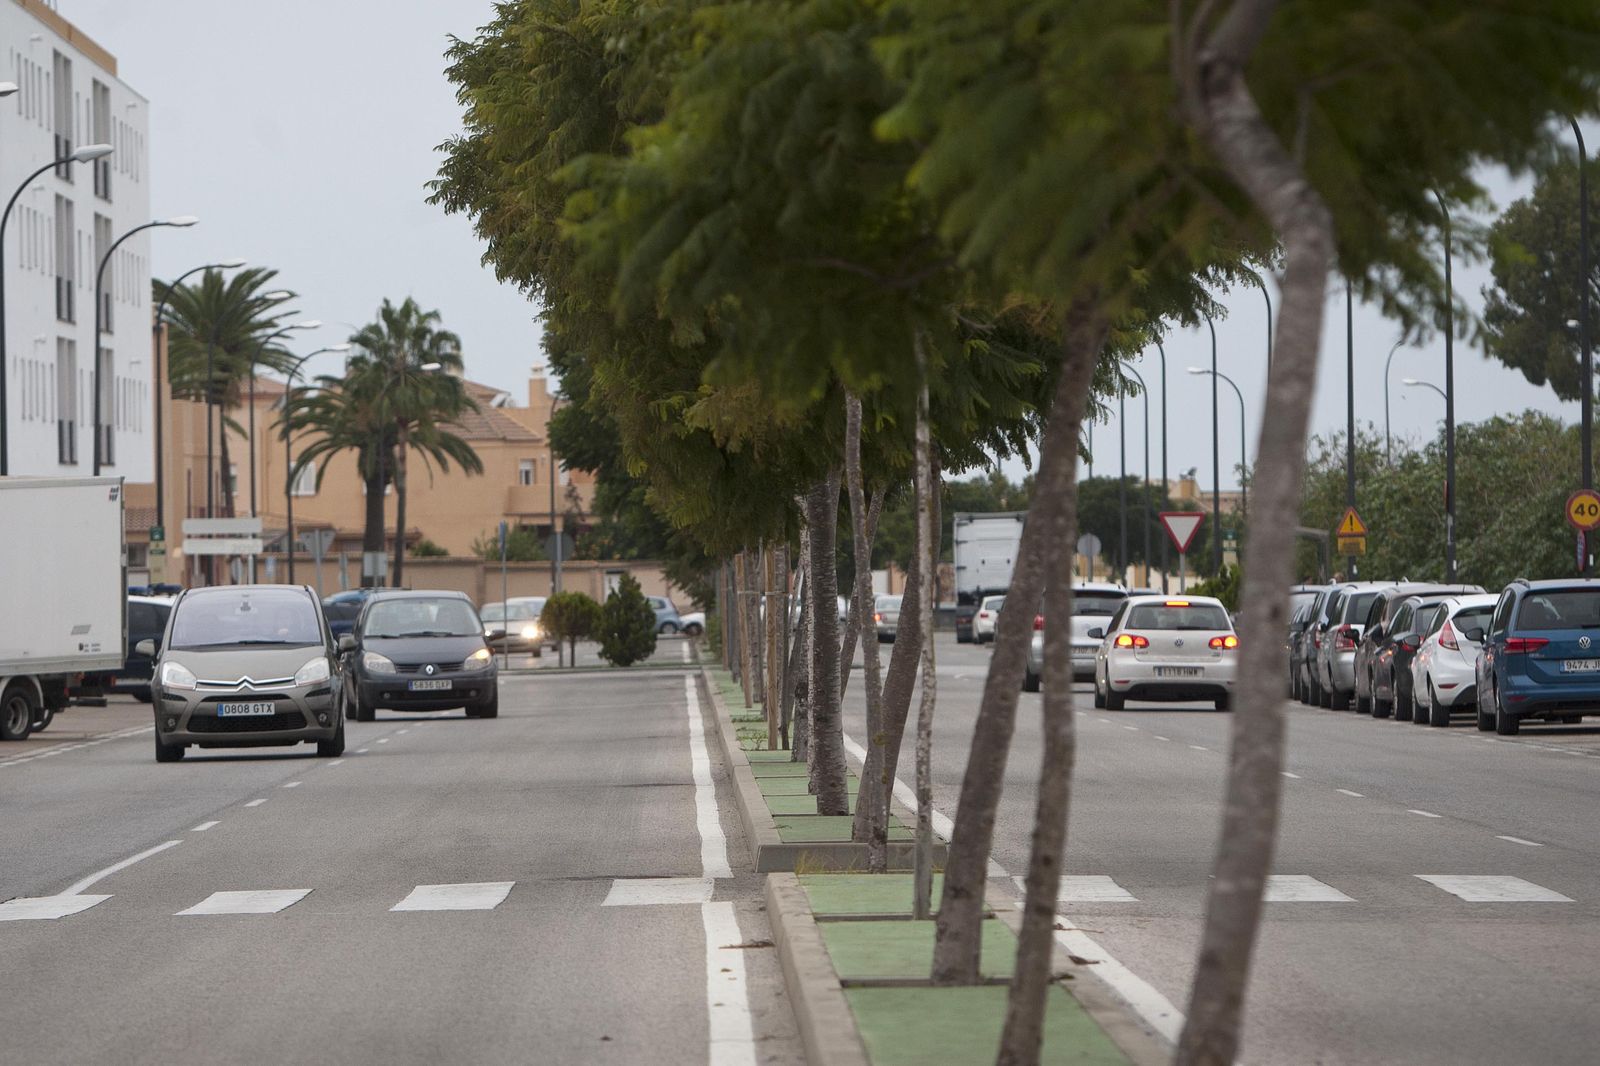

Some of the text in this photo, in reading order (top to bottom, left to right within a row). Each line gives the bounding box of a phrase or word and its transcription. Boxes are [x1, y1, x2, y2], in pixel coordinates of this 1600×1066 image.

[1574, 502, 1598, 515] 40
[1566, 660, 1589, 671] 9474
[224, 703, 273, 714] 0808 GTX
